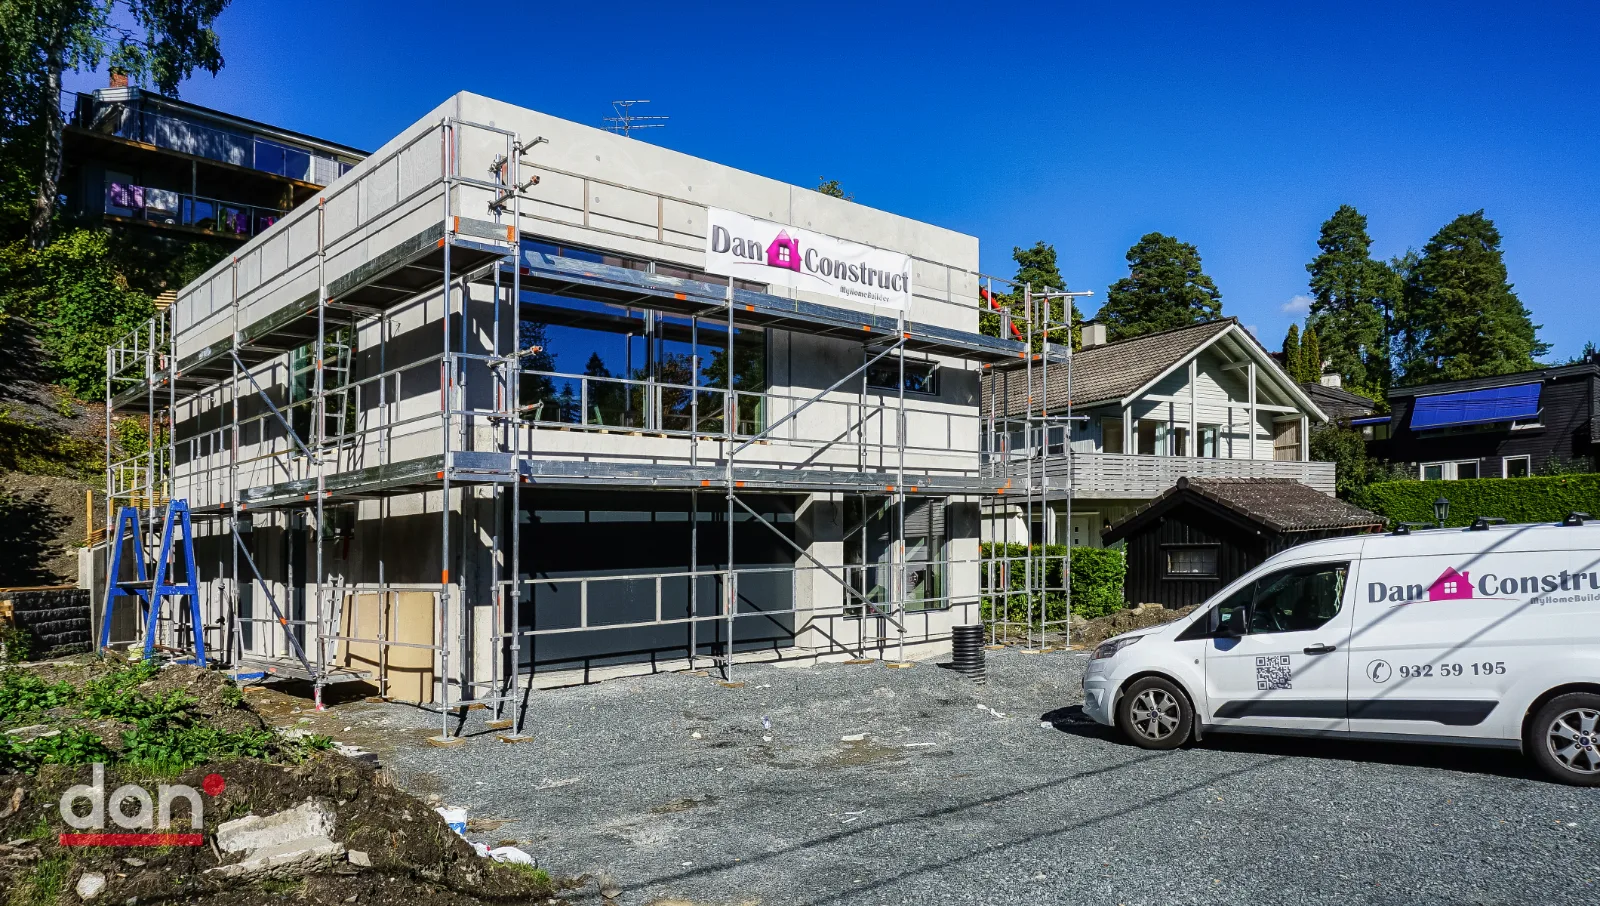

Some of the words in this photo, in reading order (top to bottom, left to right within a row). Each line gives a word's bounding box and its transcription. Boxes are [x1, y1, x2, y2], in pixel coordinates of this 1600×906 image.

[711, 224, 763, 262] Dan
[804, 247, 909, 293] Construct
[839, 285, 890, 303] MyHomeBuilder
[1368, 582, 1423, 603] Dan
[1399, 664, 1434, 678] 932
[1440, 663, 1464, 677] 59
[1470, 661, 1507, 675] 195
